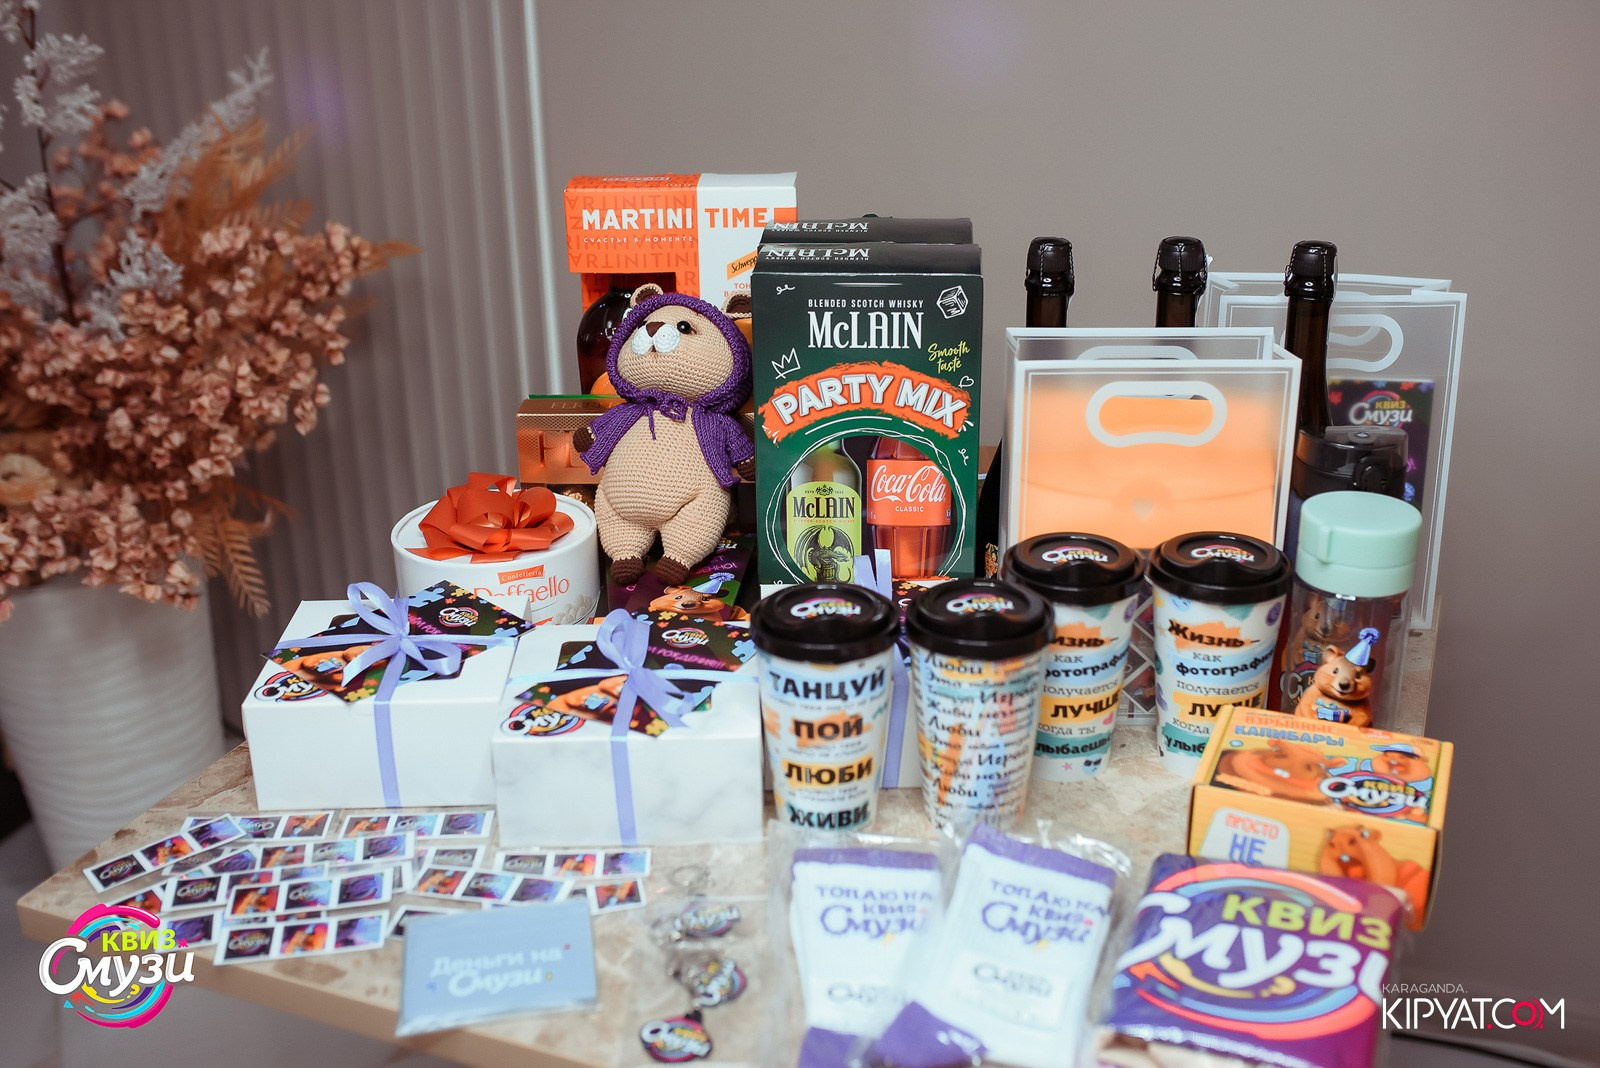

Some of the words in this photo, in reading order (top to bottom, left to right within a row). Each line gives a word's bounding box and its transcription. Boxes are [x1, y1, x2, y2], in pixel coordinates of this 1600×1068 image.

[582, 208, 693, 230] MARTINI
[704, 207, 769, 228] TIME
[808, 298, 847, 308] BLENDED
[851, 299, 885, 308] SCOTCH
[888, 299, 924, 309] WHISKY
[807, 311, 925, 350] McLAIN
[927, 340, 971, 362] Smooth
[937, 355, 962, 374] taste
[771, 372, 894, 425] PARTY
[895, 377, 967, 428] MIX
[1375, 400, 1406, 410] КВИЗ
[1349, 402, 1413, 426] Смузи
[870, 464, 947, 503] Coca-Cola
[793, 496, 856, 519] McLAIN
[501, 569, 542, 582] Confetteria
[1167, 618, 1244, 648] Жизнь
[1054, 654, 1084, 663] как
[1192, 652, 1222, 663] как
[254, 682, 315, 701] Сму
[769, 665, 886, 701] ТАНЦУЙ
[792, 713, 863, 741] ПОЙ
[1234, 725, 1344, 747] КАПИБАРЫ
[785, 756, 874, 785] ЛЮБИ
[787, 801, 870, 829] ЖИВИ
[1225, 813, 1280, 840] ПРОСТО
[1228, 833, 1266, 866] НЕ
[1221, 894, 1393, 950] КВИЗ
